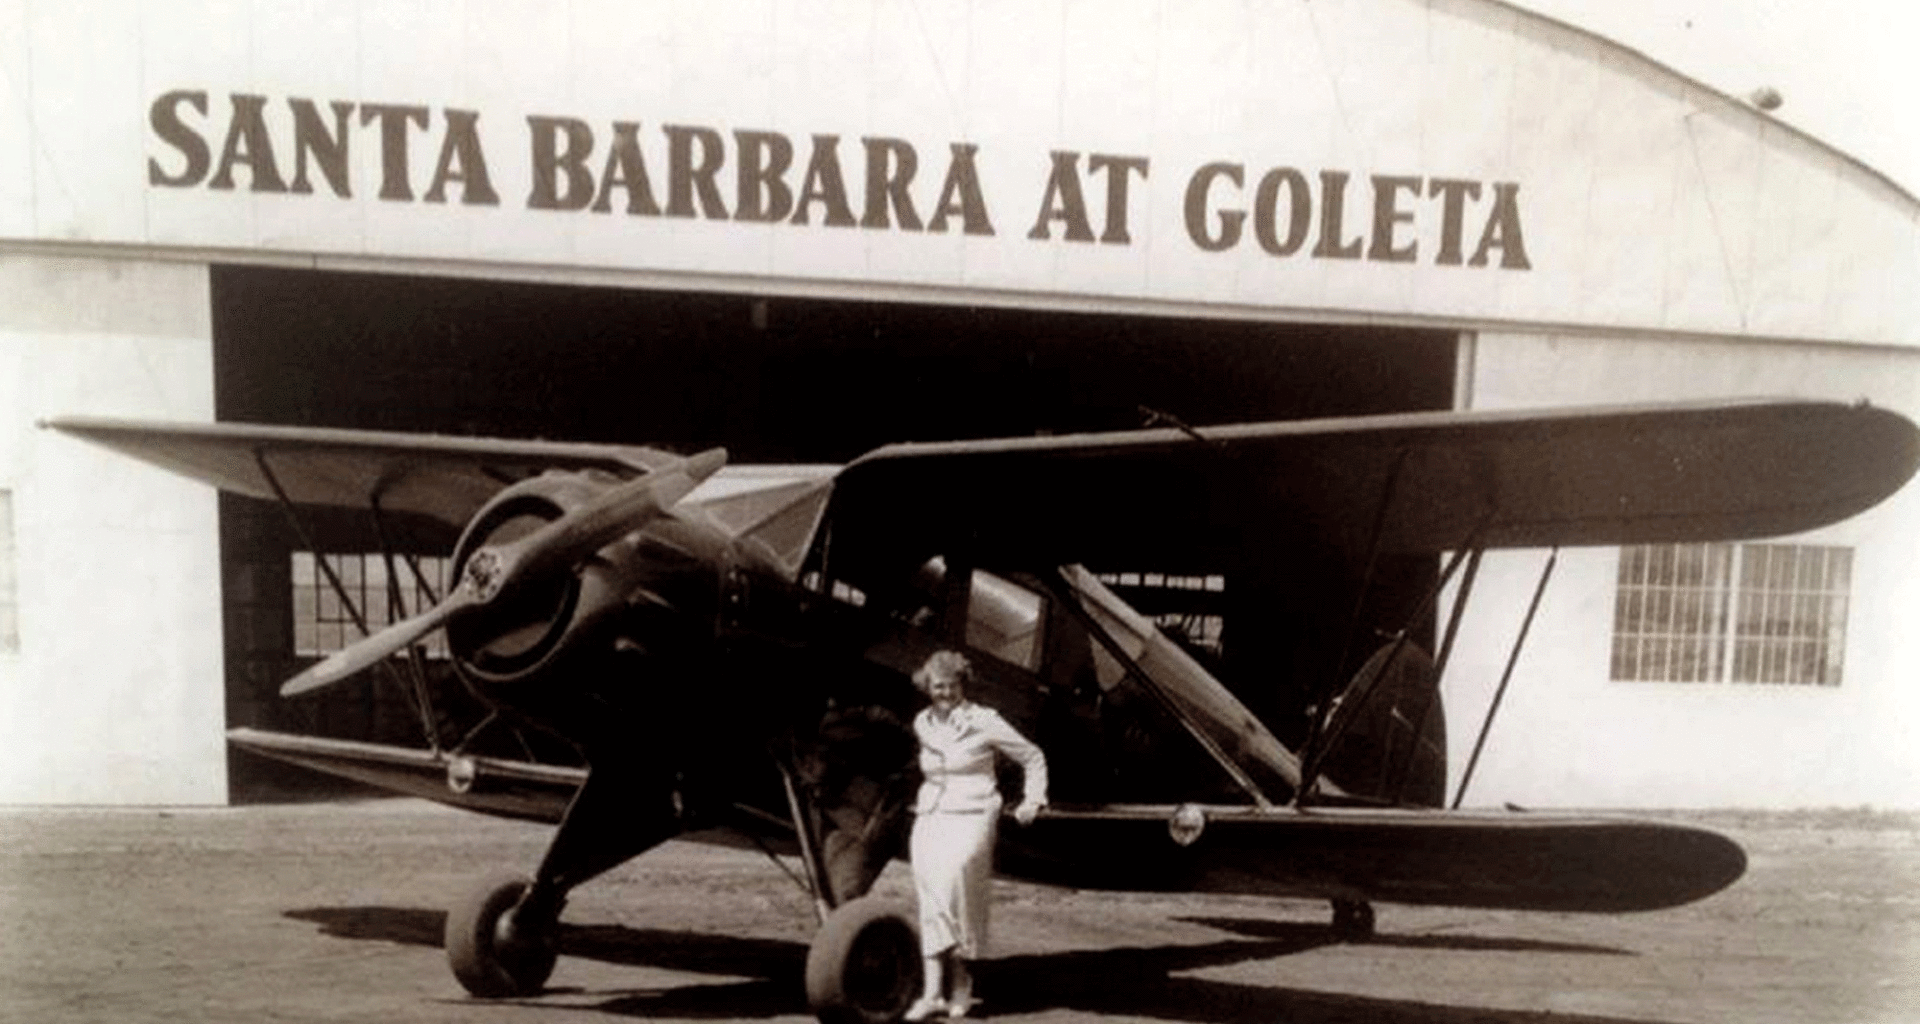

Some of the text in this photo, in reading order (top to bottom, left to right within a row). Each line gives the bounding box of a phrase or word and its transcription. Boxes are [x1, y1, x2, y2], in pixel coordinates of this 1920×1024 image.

[148, 91, 1531, 271] SANTA BARBARA AT GOLETA
